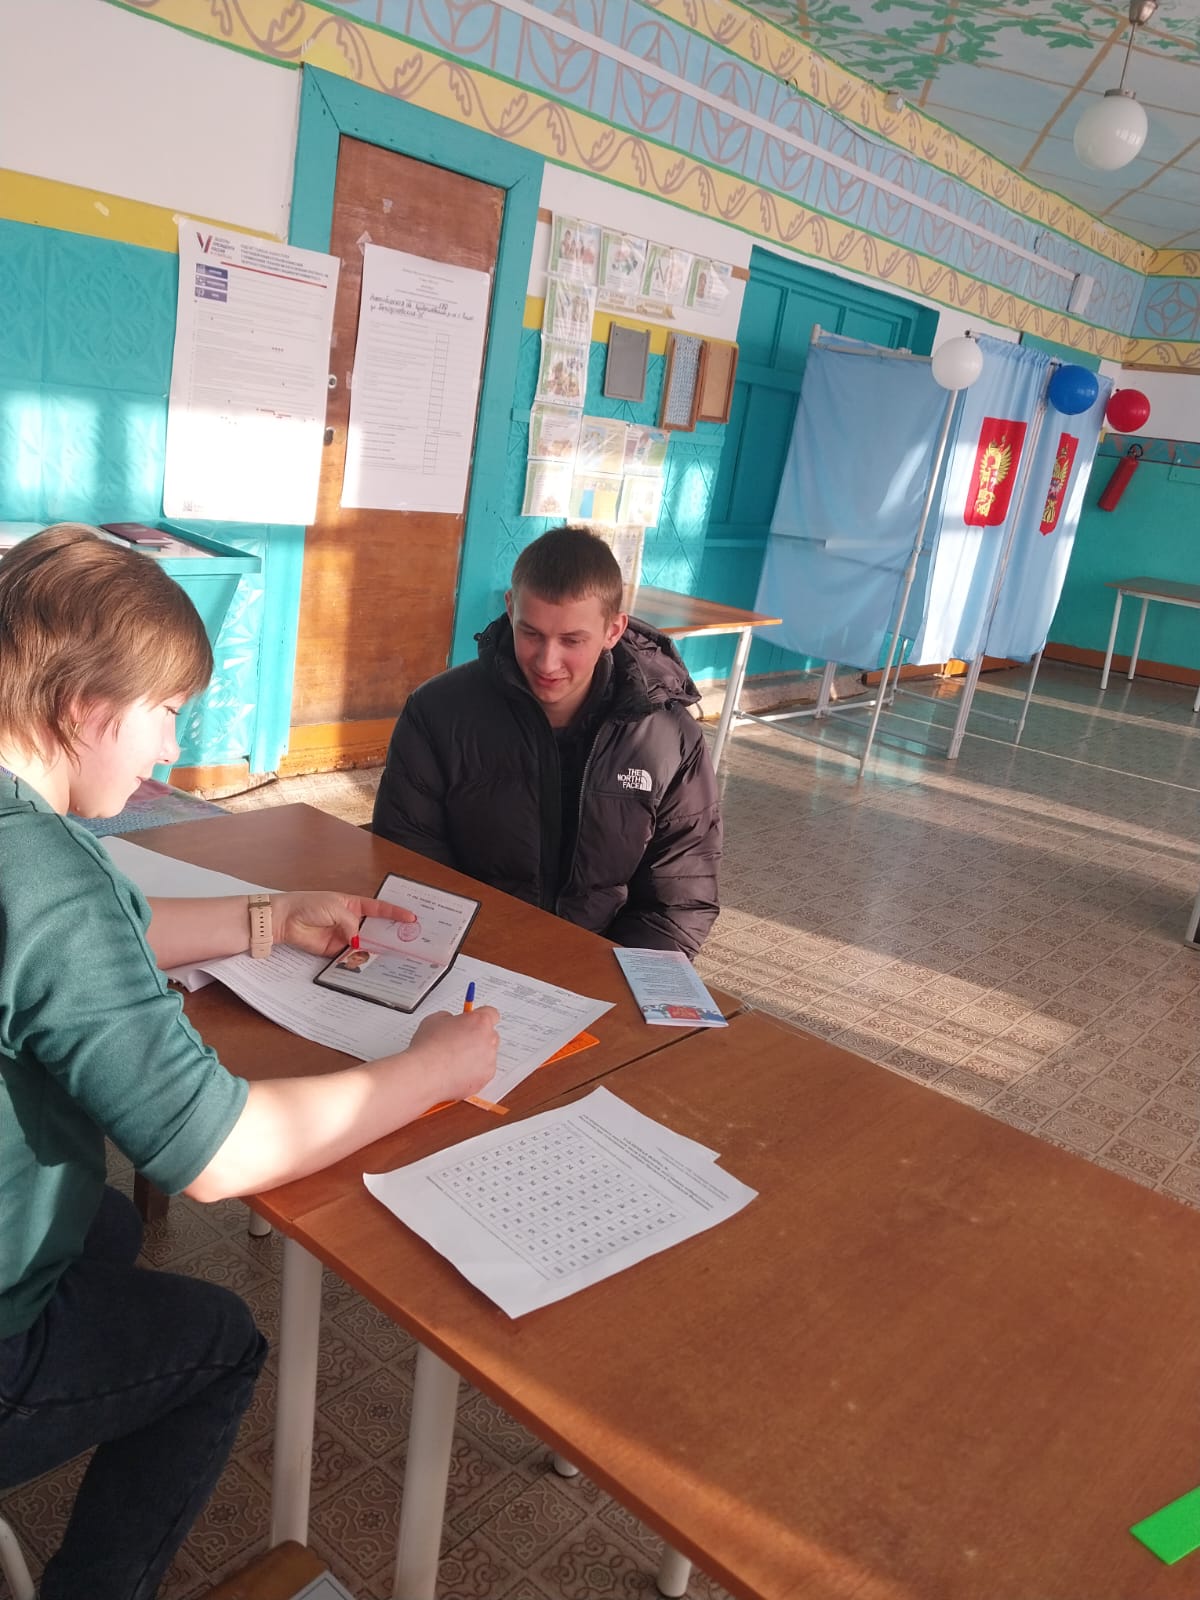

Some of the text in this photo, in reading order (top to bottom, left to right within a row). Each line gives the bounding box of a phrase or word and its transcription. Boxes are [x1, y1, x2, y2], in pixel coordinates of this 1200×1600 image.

[628, 768, 642, 776] THE
[617, 773, 641, 783] NORTH
[622, 781, 641, 789] FACE
